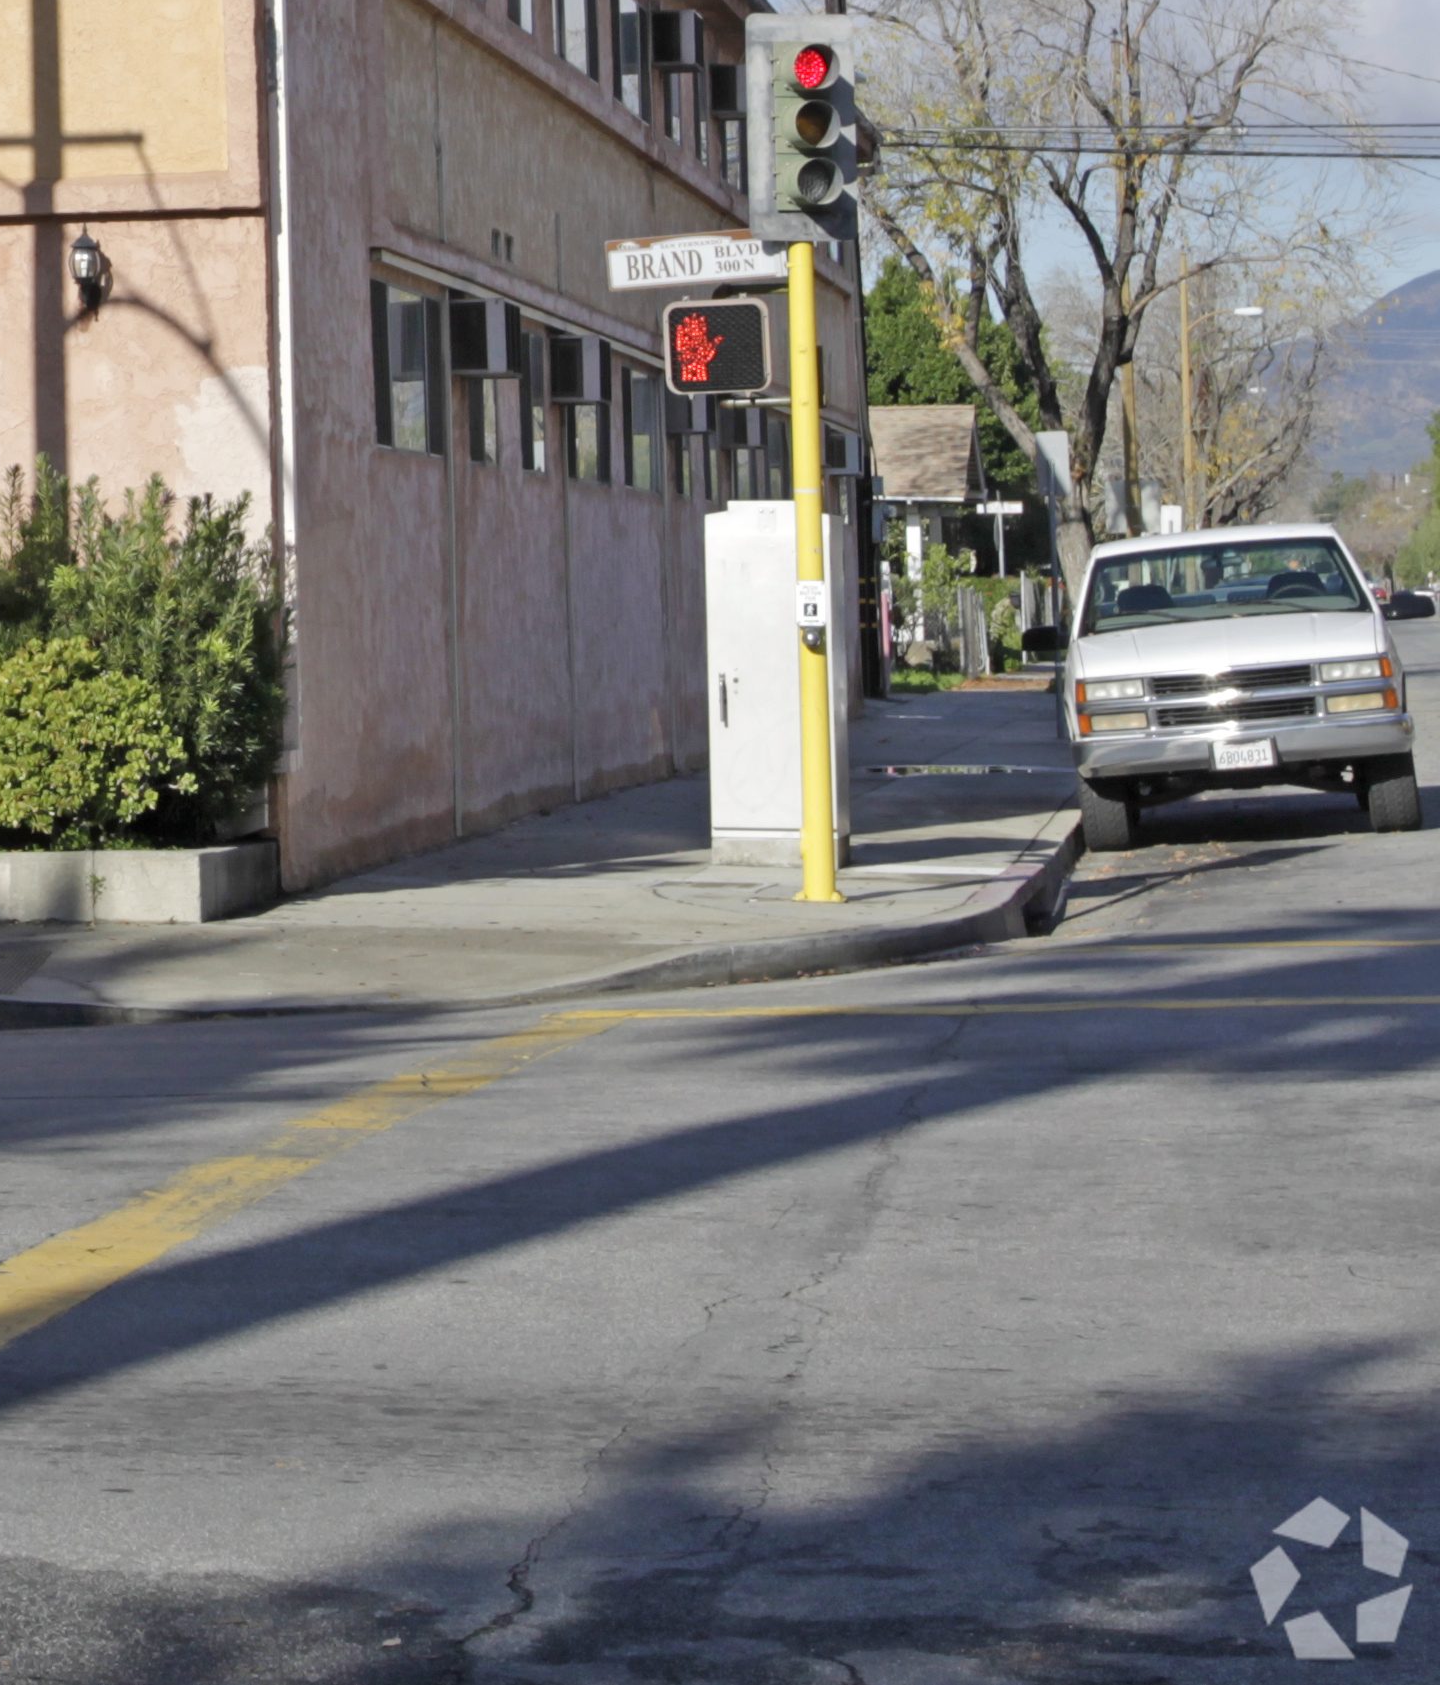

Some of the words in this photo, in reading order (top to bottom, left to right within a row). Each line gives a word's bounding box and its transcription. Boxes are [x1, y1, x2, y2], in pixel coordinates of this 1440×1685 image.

[626, 249, 703, 281] BRAND
[714, 242, 760, 258] BLVD
[715, 259, 740, 274] 300
[743, 258, 756, 272] N
